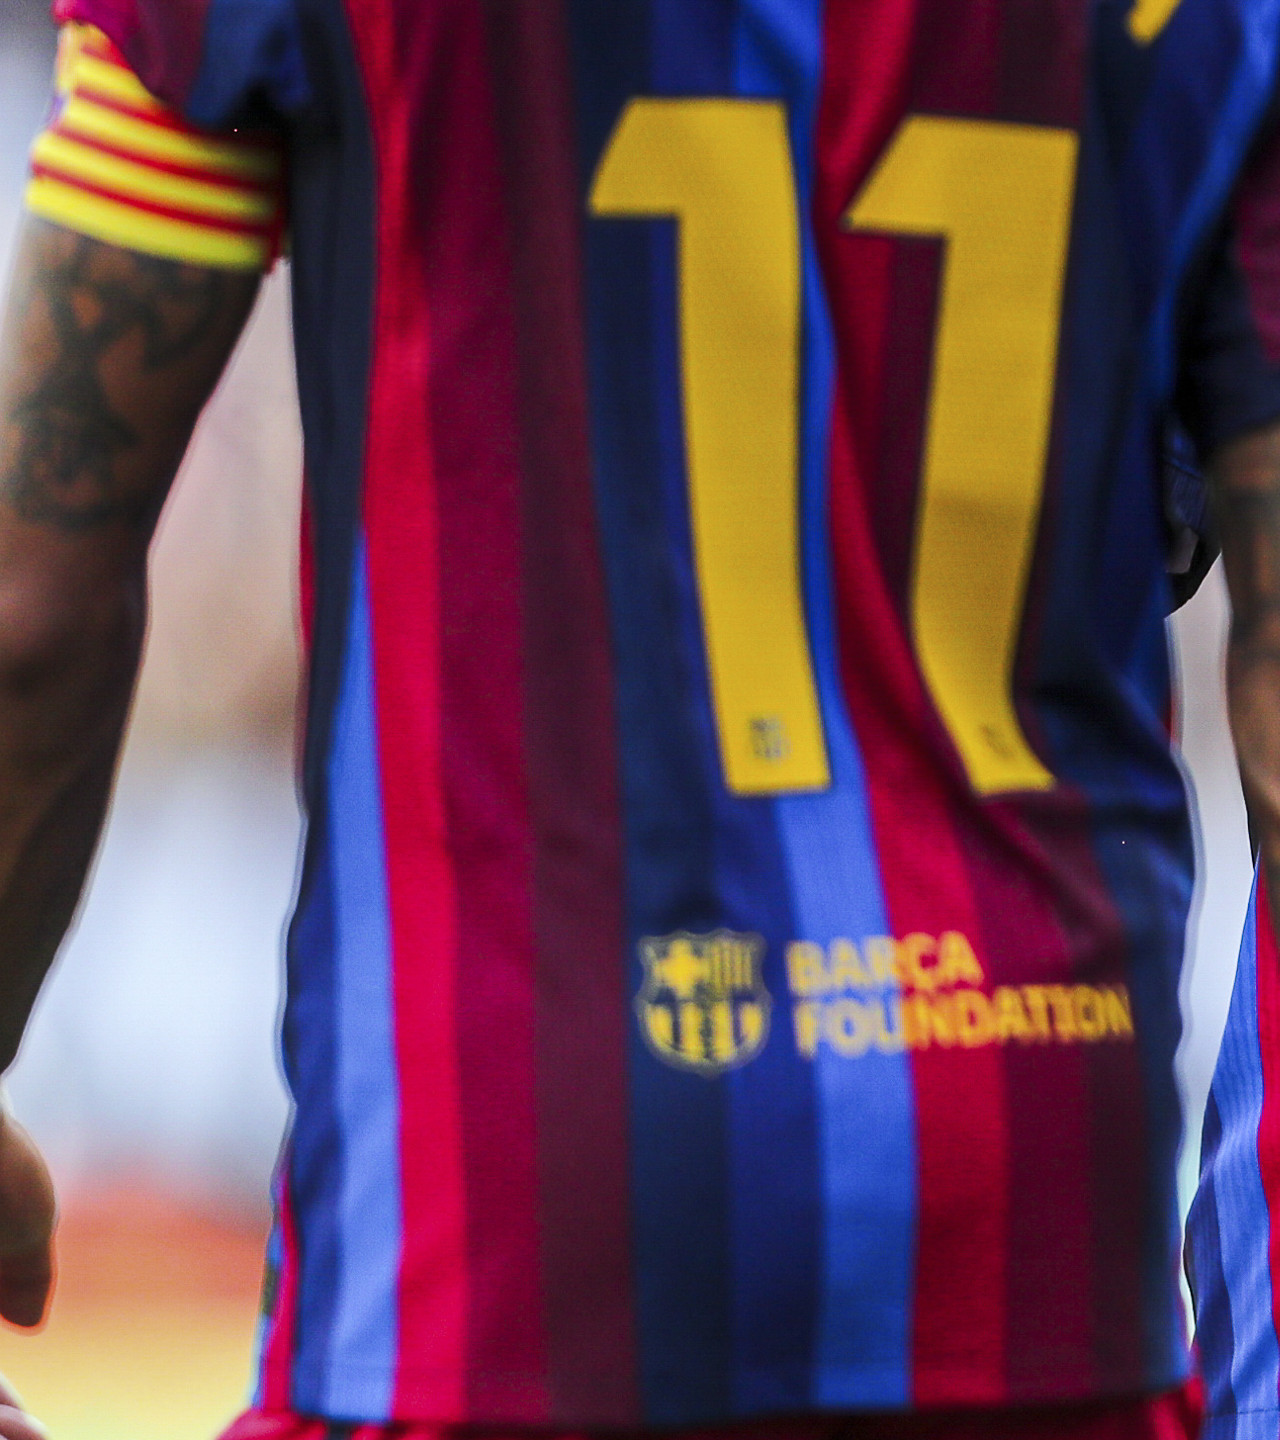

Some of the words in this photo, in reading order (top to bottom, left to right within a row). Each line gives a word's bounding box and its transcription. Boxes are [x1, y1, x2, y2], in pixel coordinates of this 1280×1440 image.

[588, 96, 1081, 797] 11
[784, 930, 985, 997] BARÇA
[793, 982, 1135, 1059] FOUNDATION
